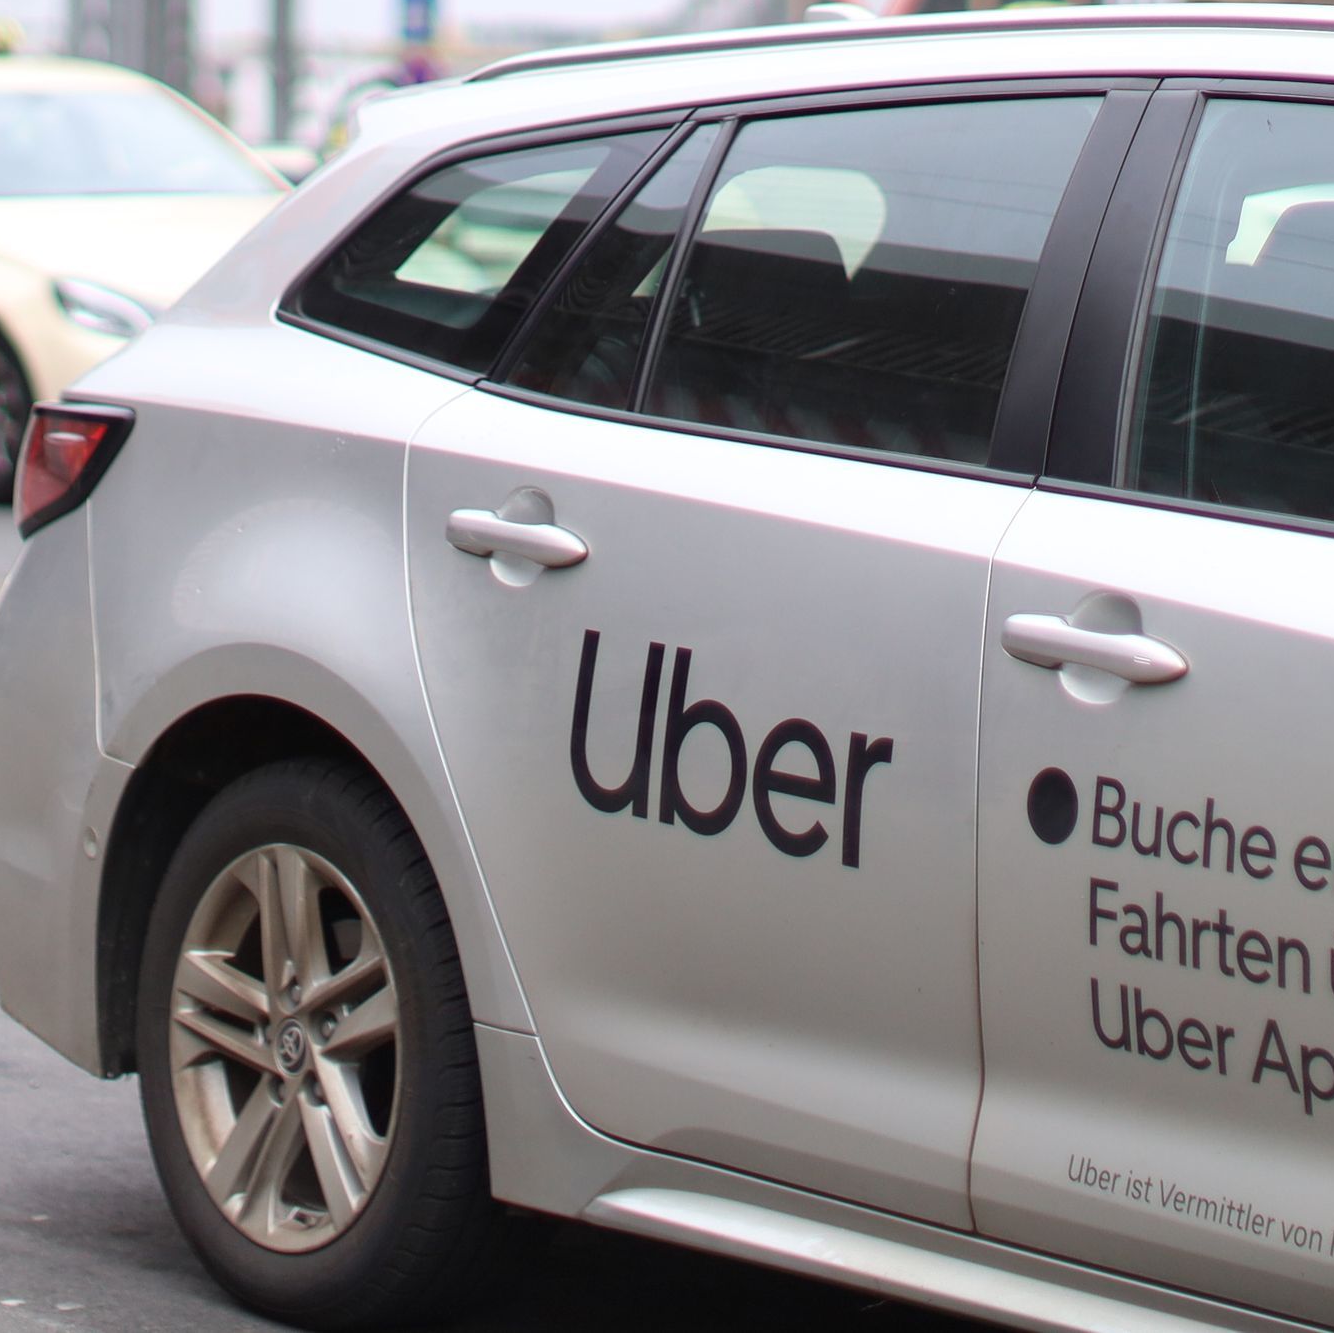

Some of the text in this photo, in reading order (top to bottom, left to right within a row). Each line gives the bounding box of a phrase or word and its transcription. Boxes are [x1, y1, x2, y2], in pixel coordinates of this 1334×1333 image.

[569, 628, 895, 870] Uber
[1091, 775, 1277, 880] Buche
[1089, 877, 1312, 995] Fahrten
[1090, 977, 1236, 1076] Uber
[1067, 1153, 1121, 1193] Uber
[1124, 1170, 1154, 1204] ist
[1158, 1179, 1276, 1238] Vermittler
[1281, 1220, 1323, 1253] von
